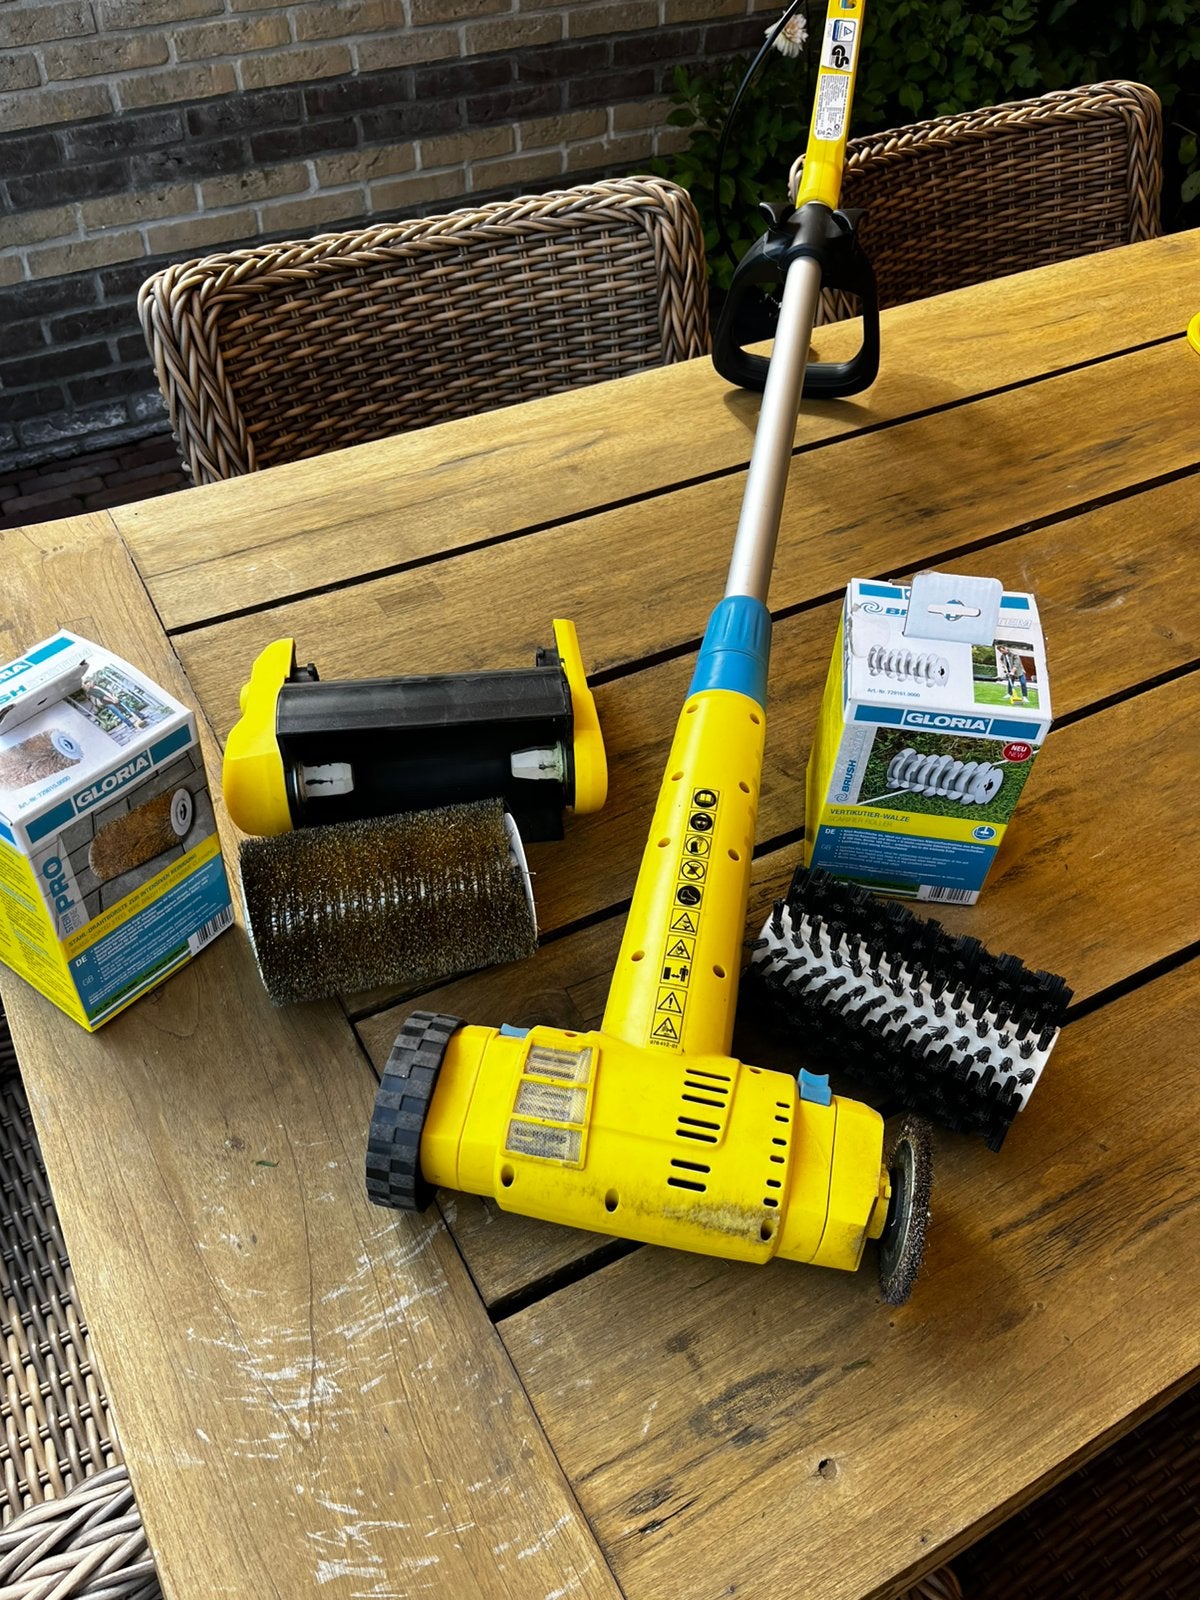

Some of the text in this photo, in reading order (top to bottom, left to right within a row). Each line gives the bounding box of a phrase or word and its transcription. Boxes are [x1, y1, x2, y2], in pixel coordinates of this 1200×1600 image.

[906, 712, 986, 731] GLORIA
[1007, 750, 1025, 759] NEW
[1010, 744, 1028, 753] NEU
[76, 756, 149, 807] GLORIA
[841, 759, 857, 793] BRUSH
[830, 808, 911, 823] VERTIKUTIER-WALZE
[42, 856, 76, 915] PRO
[61, 913, 74, 934] STEIN
[75, 954, 88, 968] DE
[82, 975, 95, 987] GB
